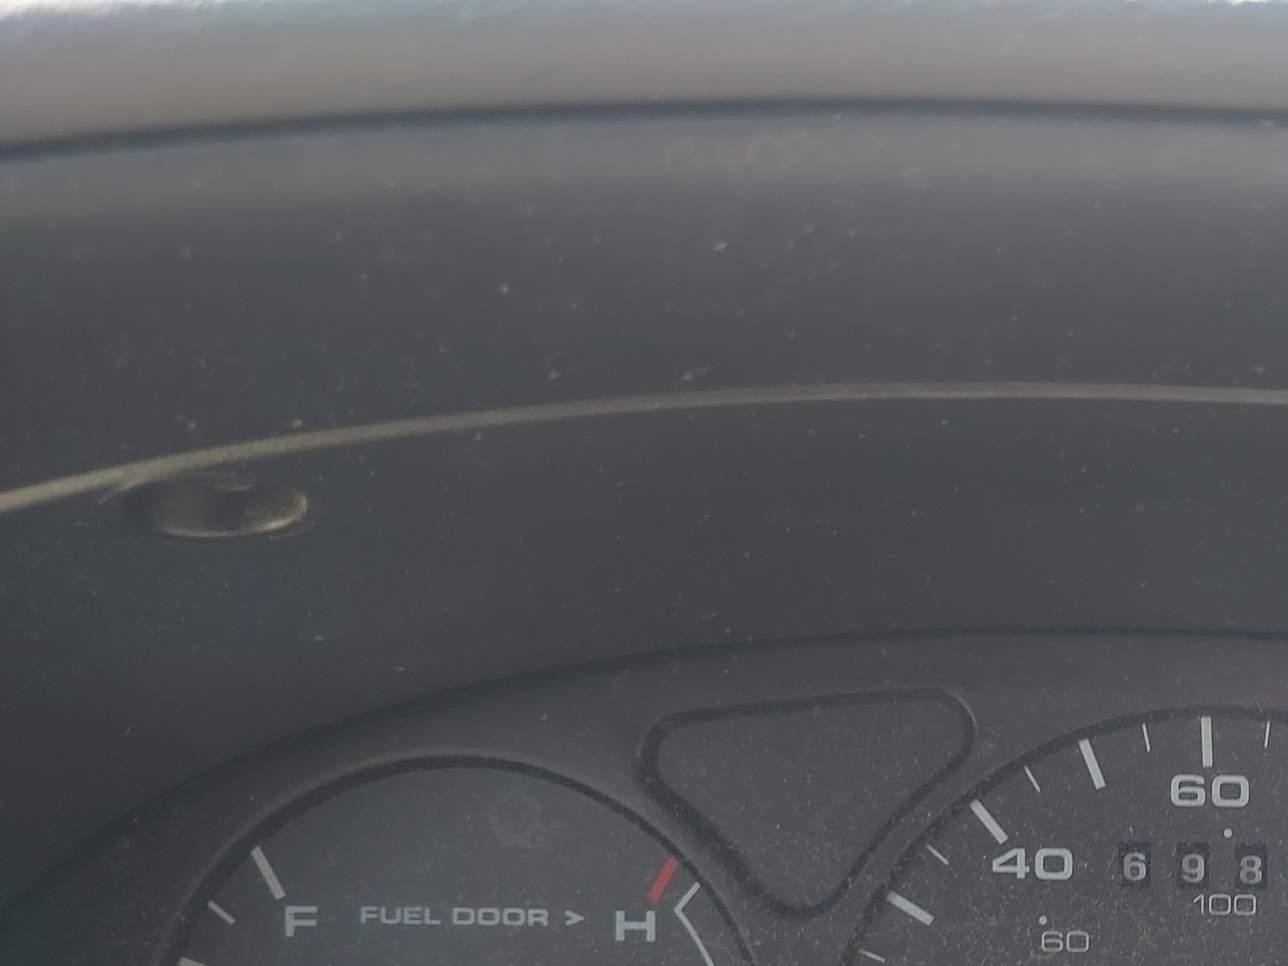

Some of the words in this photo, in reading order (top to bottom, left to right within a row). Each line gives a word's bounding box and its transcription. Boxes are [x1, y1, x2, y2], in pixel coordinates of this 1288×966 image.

[1170, 774, 1250, 807] 60
[992, 847, 1073, 880] 40
[360, 906, 441, 925] FUEL
[452, 907, 549, 927] DOOR
[1193, 893, 1257, 916] 100
[284, 905, 318, 937] F
[615, 910, 656, 942] H
[1041, 930, 1090, 953] 60
